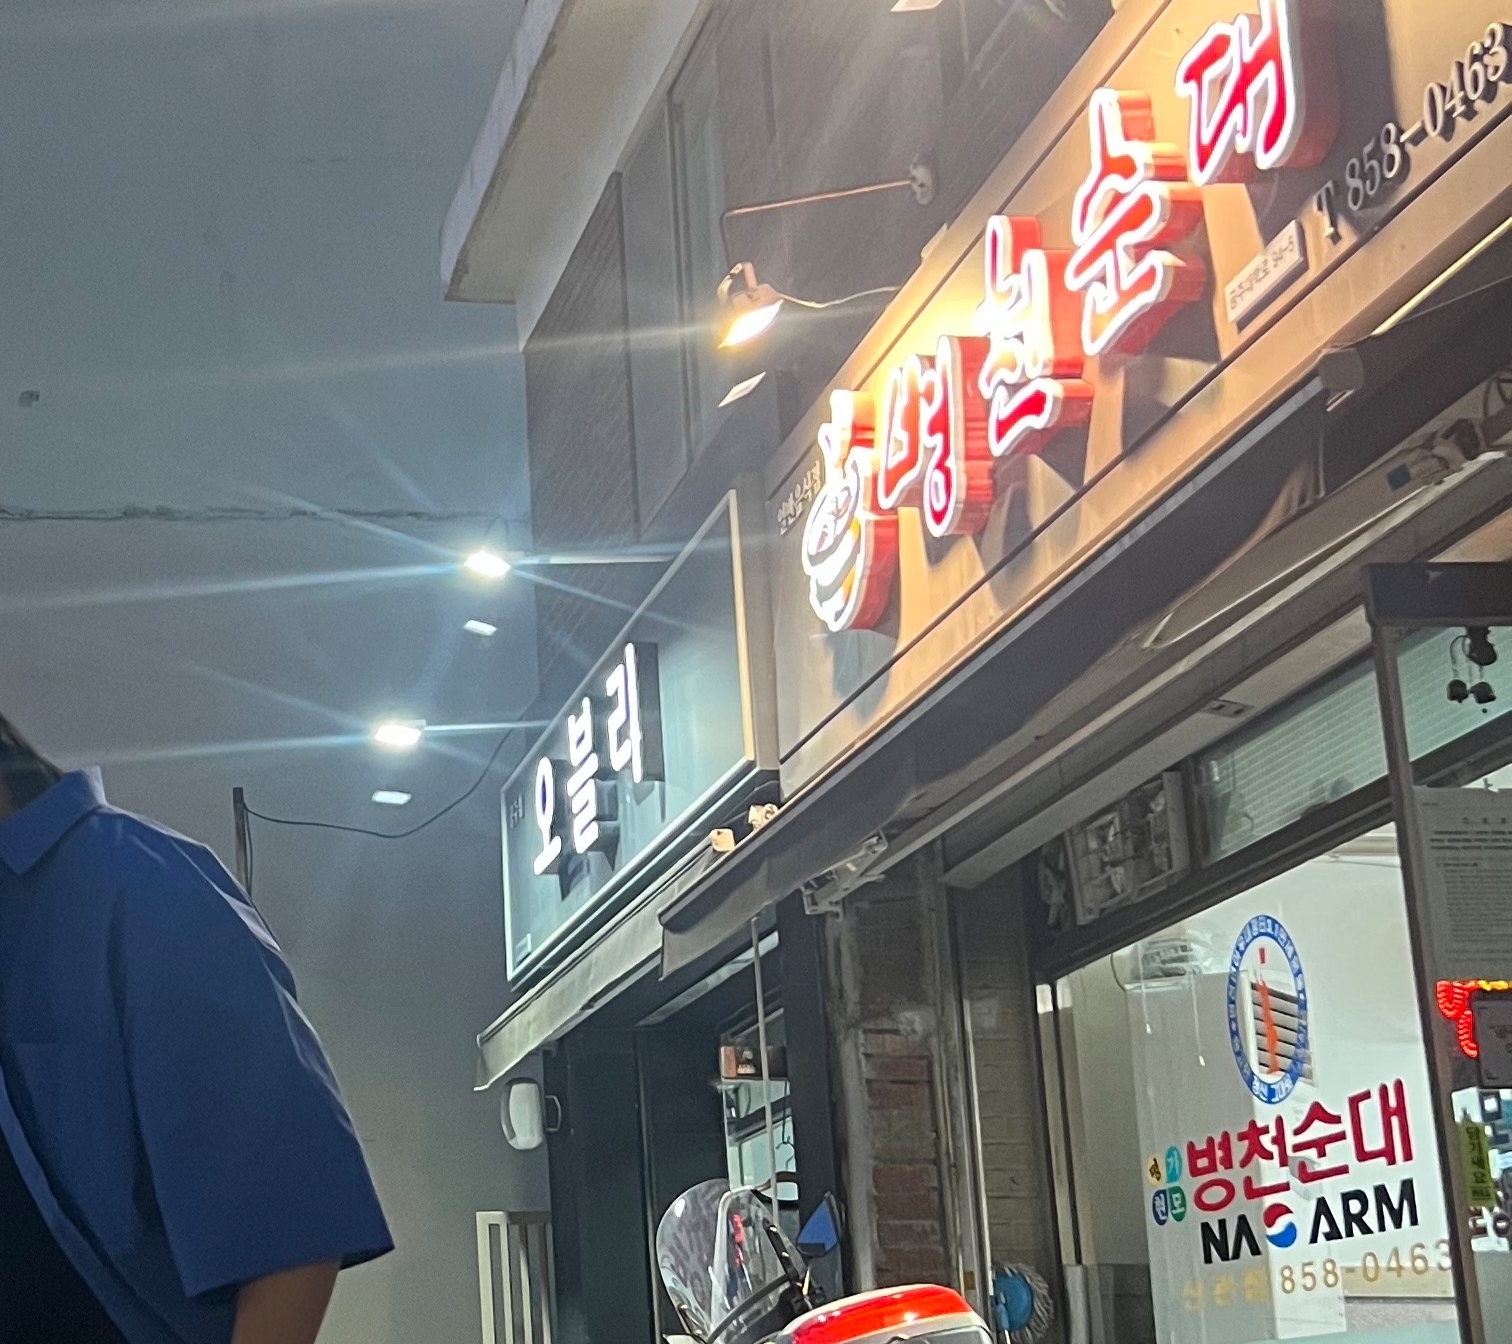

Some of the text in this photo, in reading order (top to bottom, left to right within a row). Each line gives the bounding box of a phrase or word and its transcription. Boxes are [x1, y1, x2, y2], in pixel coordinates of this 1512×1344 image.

[1344, 22, 1508, 212] 858-0463
[533, 642, 643, 876] 오블리
[1186, 1078, 1414, 1212] 병천순대
[1280, 1237, 1452, 1295] 858-0463
